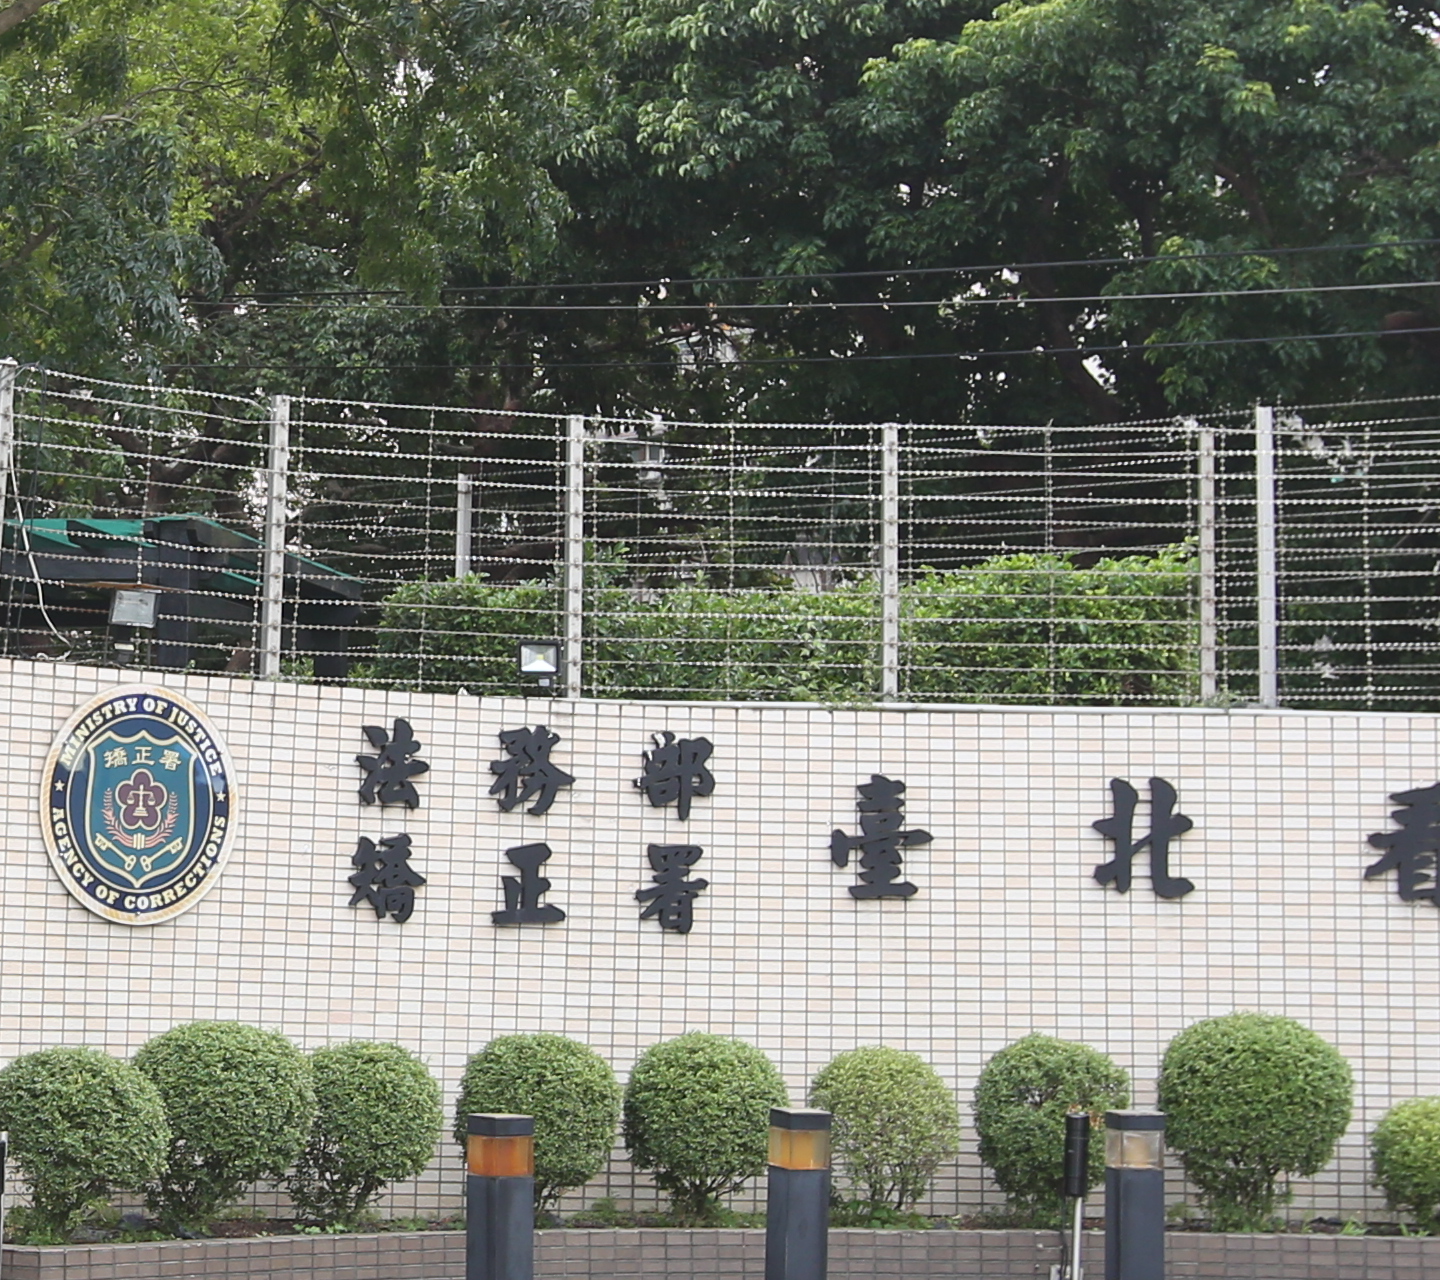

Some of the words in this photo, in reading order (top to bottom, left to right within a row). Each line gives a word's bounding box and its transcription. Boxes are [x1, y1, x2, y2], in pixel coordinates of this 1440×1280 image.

[60, 697, 138, 766] MINISTRY
[143, 698, 168, 715] OF
[168, 705, 223, 777] JUSTICE
[103, 746, 182, 771] 矯正署
[357, 719, 714, 820] 法務部
[51, 807, 95, 889] AGENCY
[95, 882, 121, 904] OF
[124, 815, 226, 910] CORRECTIONS
[349, 835, 707, 934] 矯正署
